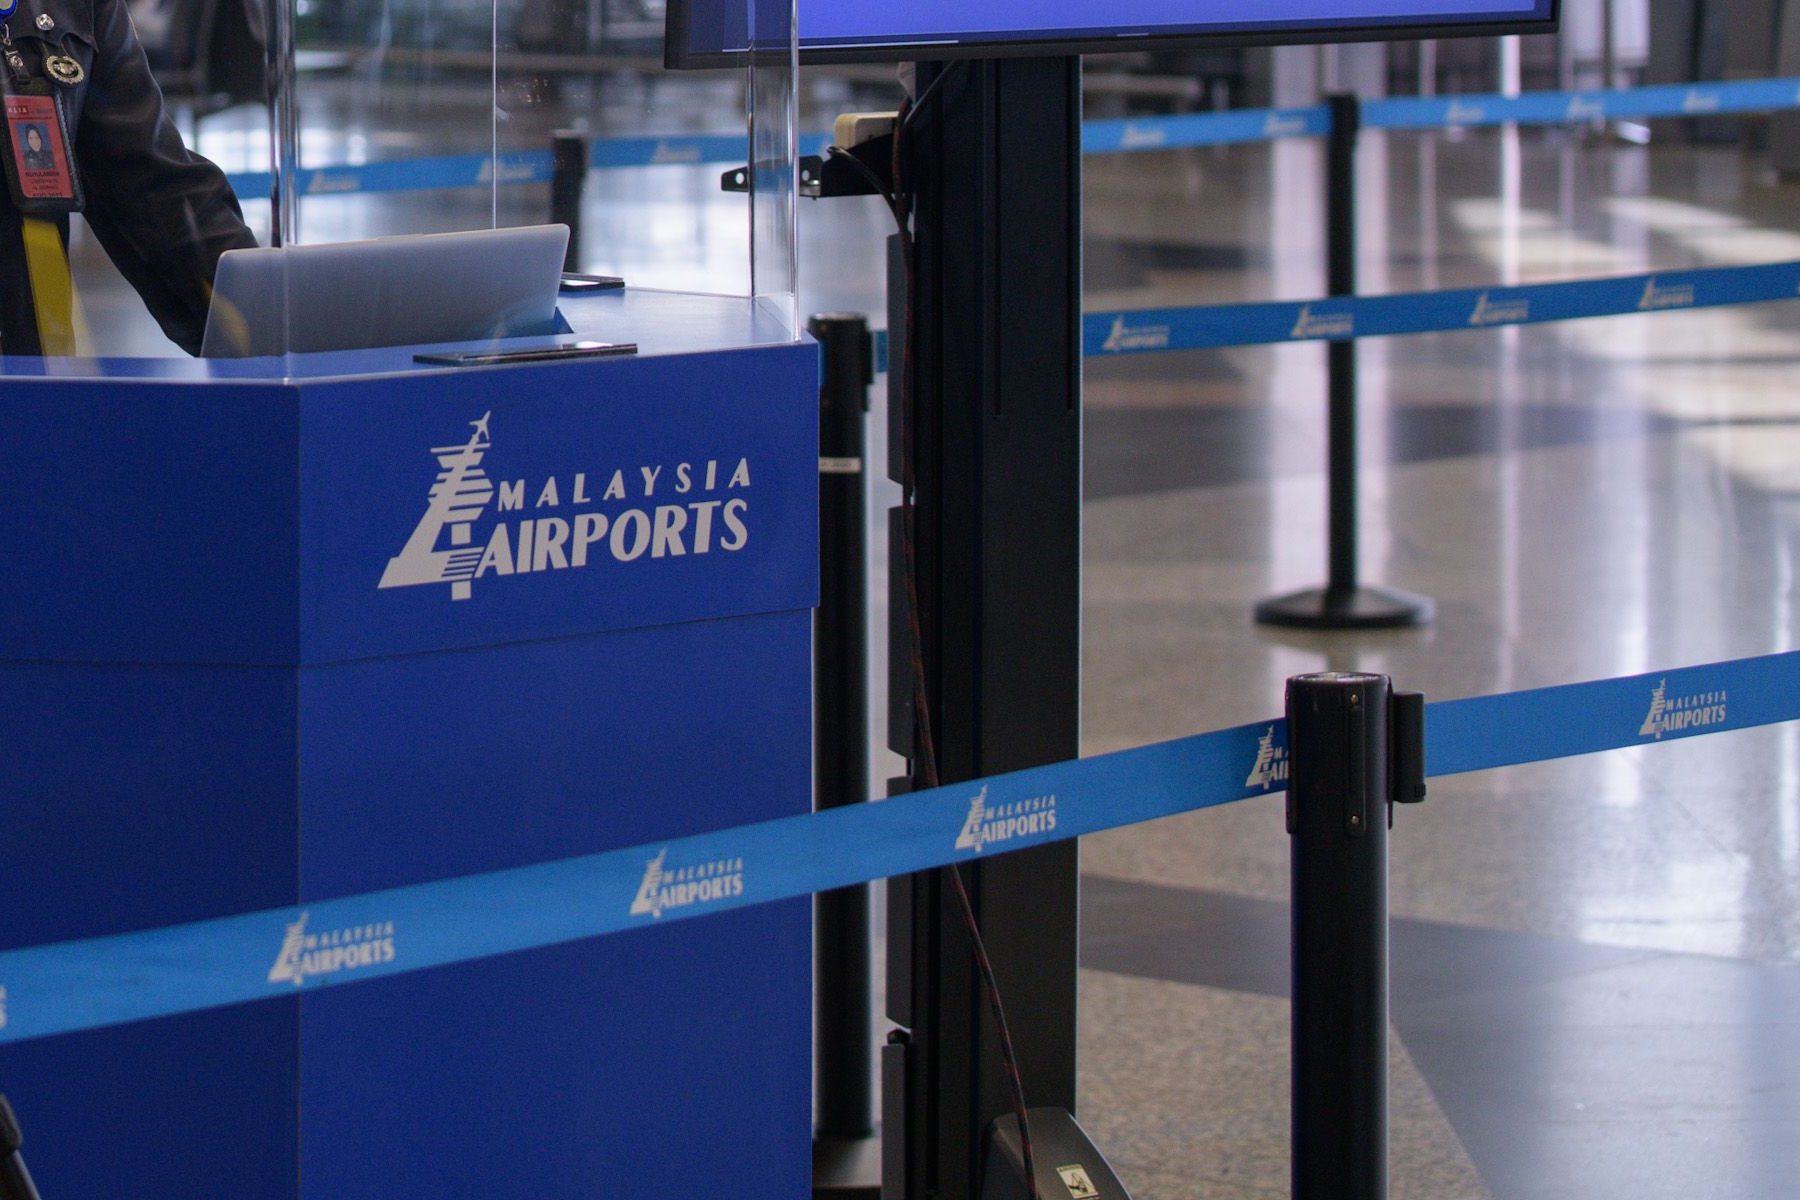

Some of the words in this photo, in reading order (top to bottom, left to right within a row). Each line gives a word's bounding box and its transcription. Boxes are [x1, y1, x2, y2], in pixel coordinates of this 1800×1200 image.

[497, 457, 751, 512] MALAYSIA
[474, 498, 748, 578] AIRPORTS
[1662, 704, 1727, 731] AIRPORTS
[1666, 690, 1727, 711] MALAYSIA
[985, 793, 1056, 820] MALAYSIA
[981, 808, 1057, 843] AIRPORTS
[664, 856, 743, 884] MALAYSIA
[659, 872, 743, 909] AIRPORTS
[300, 936, 395, 976] AIRPORTS
